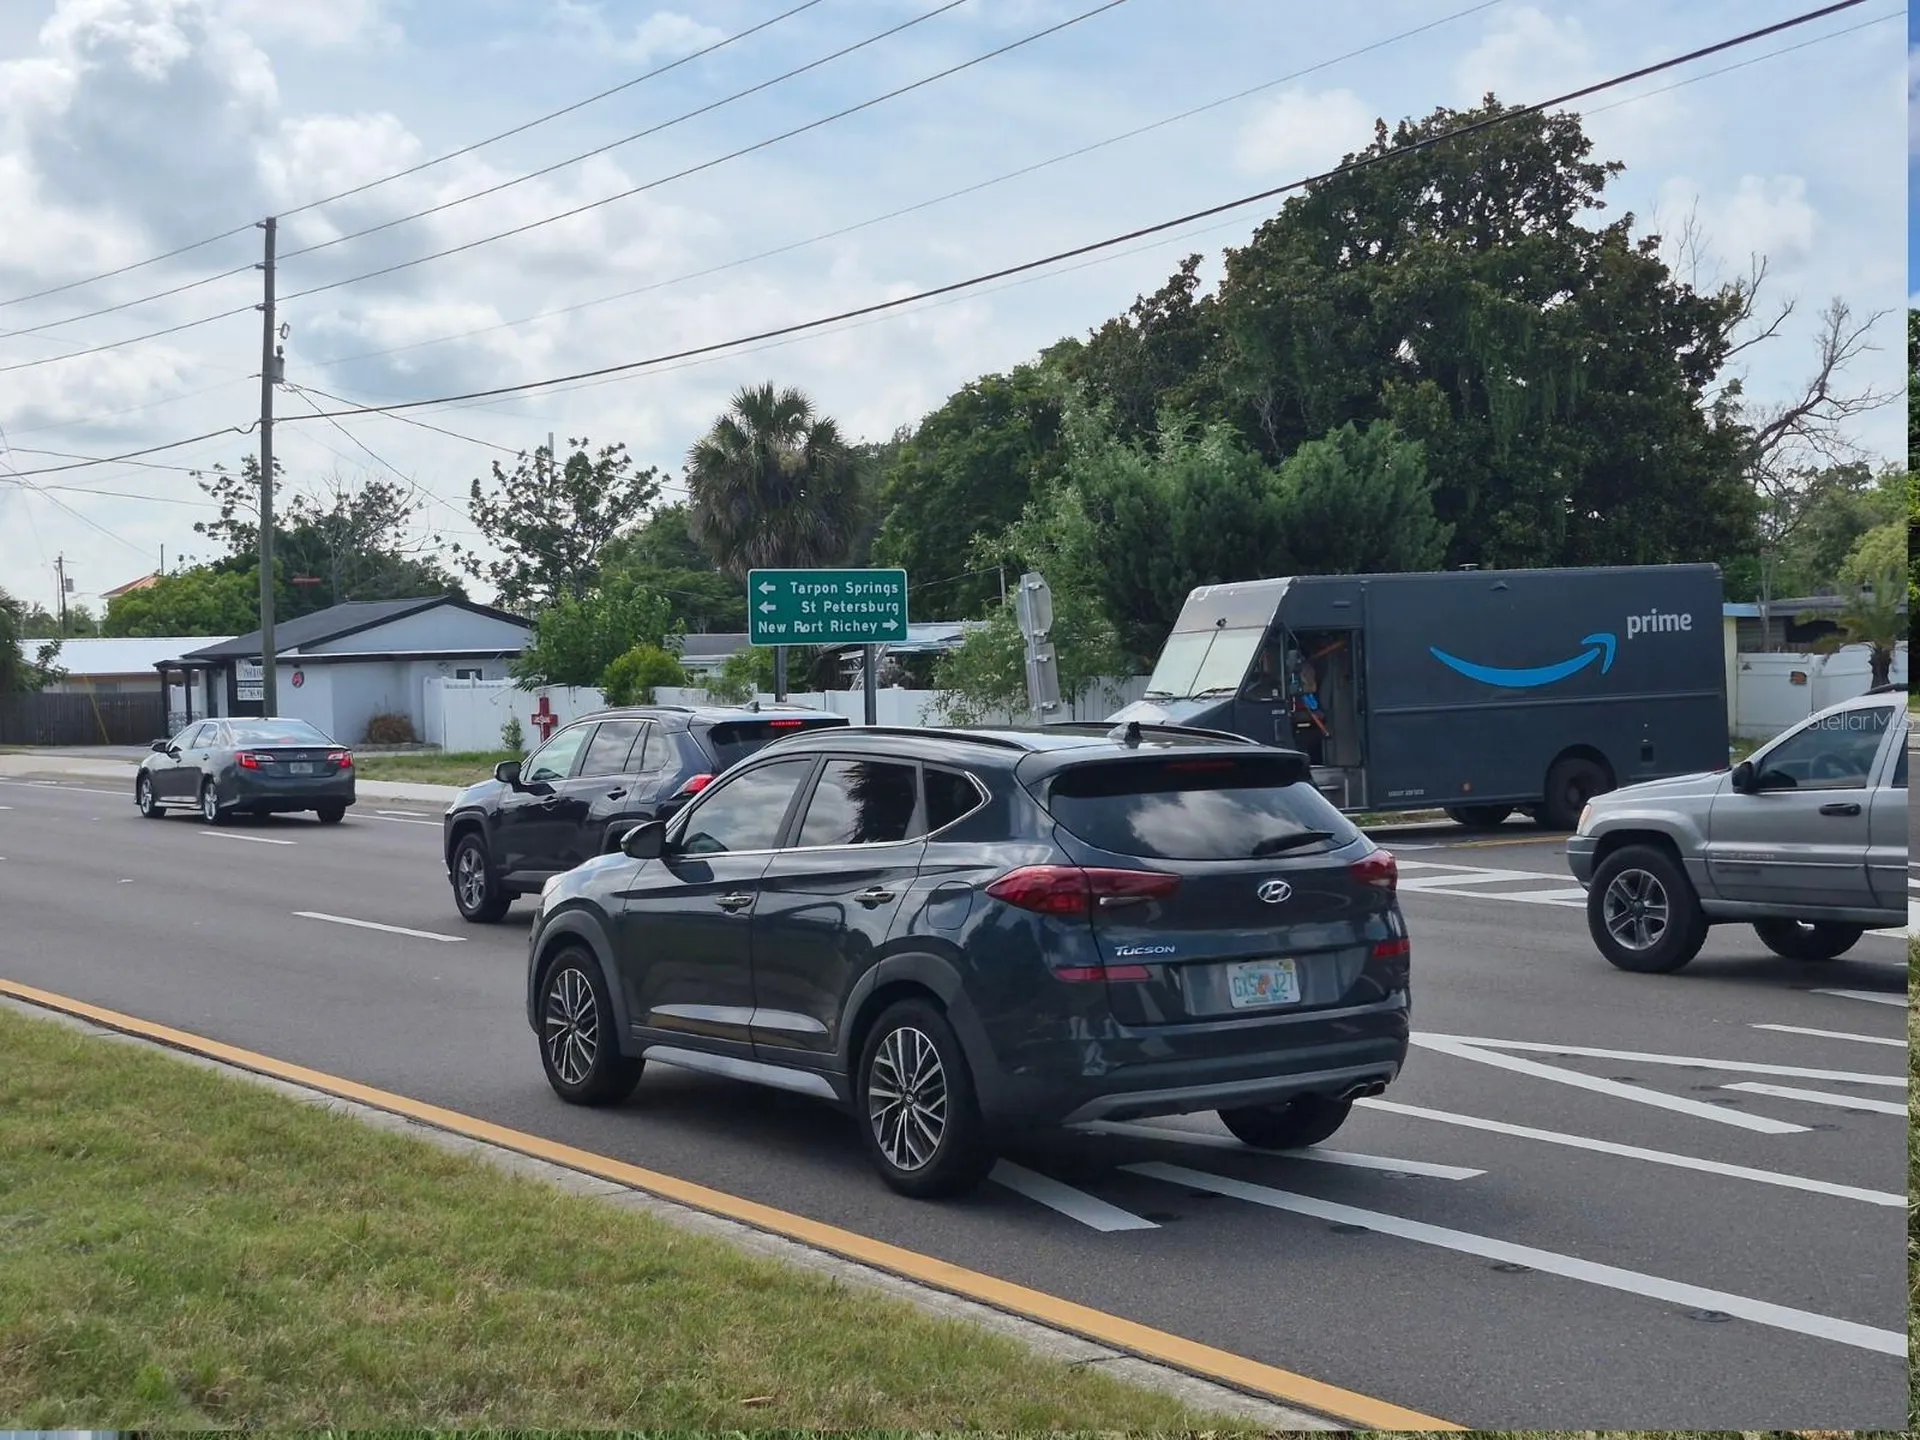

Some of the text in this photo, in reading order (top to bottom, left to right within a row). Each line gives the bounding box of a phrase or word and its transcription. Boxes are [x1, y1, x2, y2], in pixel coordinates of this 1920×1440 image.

[790, 581, 899, 597] Tarpon Springs
[801, 601, 899, 615] St Petersburg
[758, 620, 878, 634] New Port Richey
[1626, 608, 1692, 640] prime
